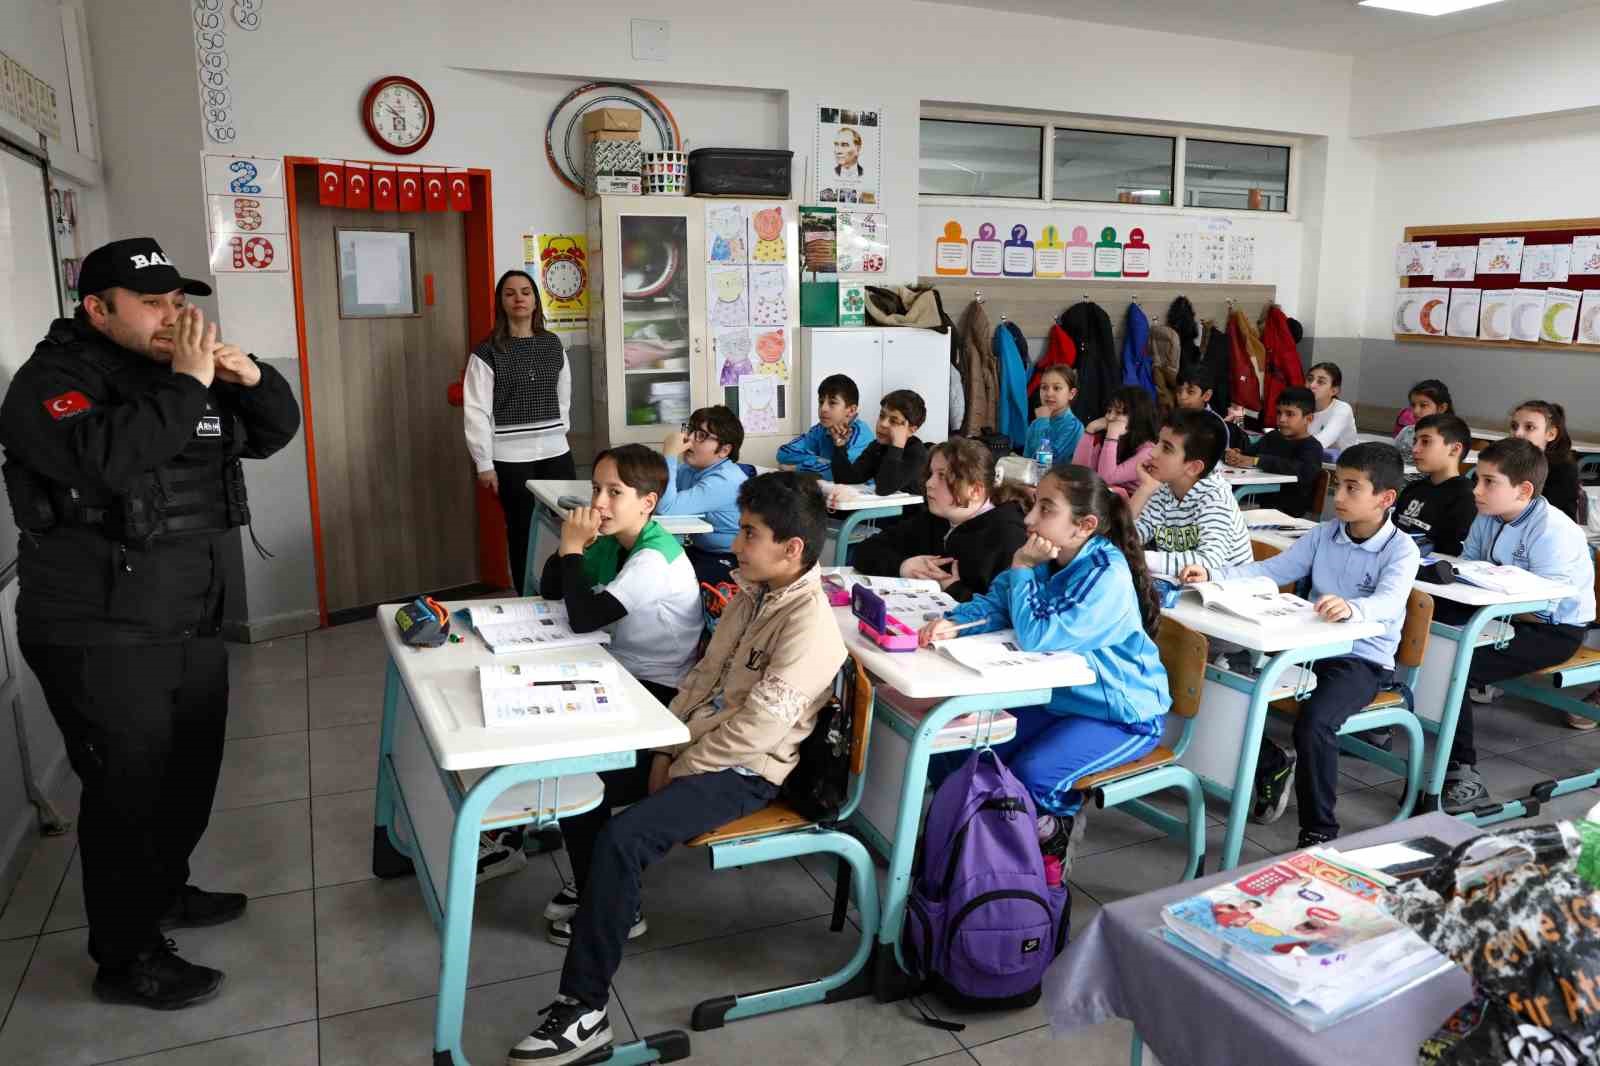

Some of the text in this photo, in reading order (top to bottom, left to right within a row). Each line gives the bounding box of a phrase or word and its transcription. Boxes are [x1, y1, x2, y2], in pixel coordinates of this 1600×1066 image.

[201, 13, 219, 29] 40
[240, 10, 258, 26] 20
[200, 32, 225, 50] 50
[205, 53, 222, 68] 60
[206, 70, 223, 86] 70
[208, 90, 226, 106] 80
[215, 127, 236, 141] 100
[230, 160, 262, 193] 2
[234, 198, 262, 231] 5
[228, 236, 274, 269] 10
